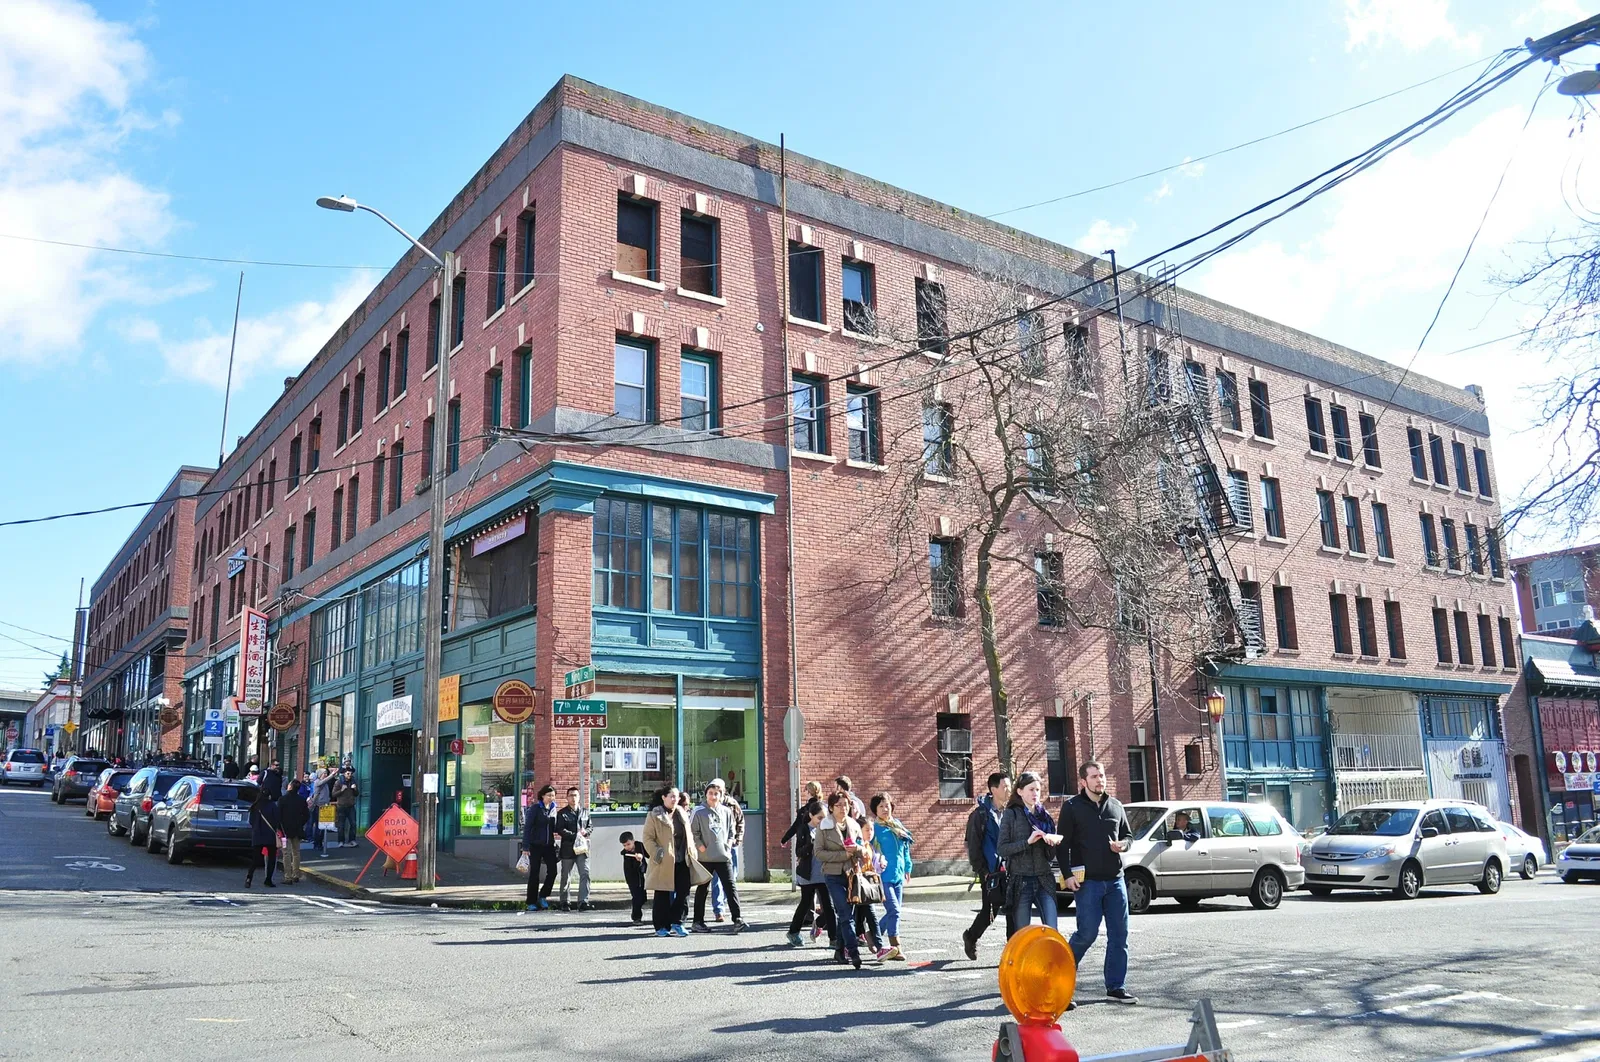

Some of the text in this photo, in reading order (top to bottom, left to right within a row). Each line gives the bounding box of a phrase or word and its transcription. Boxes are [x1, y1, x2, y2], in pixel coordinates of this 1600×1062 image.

[555, 701, 605, 712] 7th Ave S
[555, 715, 605, 726] 南第七大道
[211, 722, 218, 730] 2
[375, 738, 411, 747] BARCLA
[603, 737, 659, 749] CELL PHONE REPAIR
[375, 747, 412, 755] SEAFOO
[384, 818, 407, 826] ROAD
[385, 828, 408, 837] WORK
[384, 838, 412, 847] AHEAD
